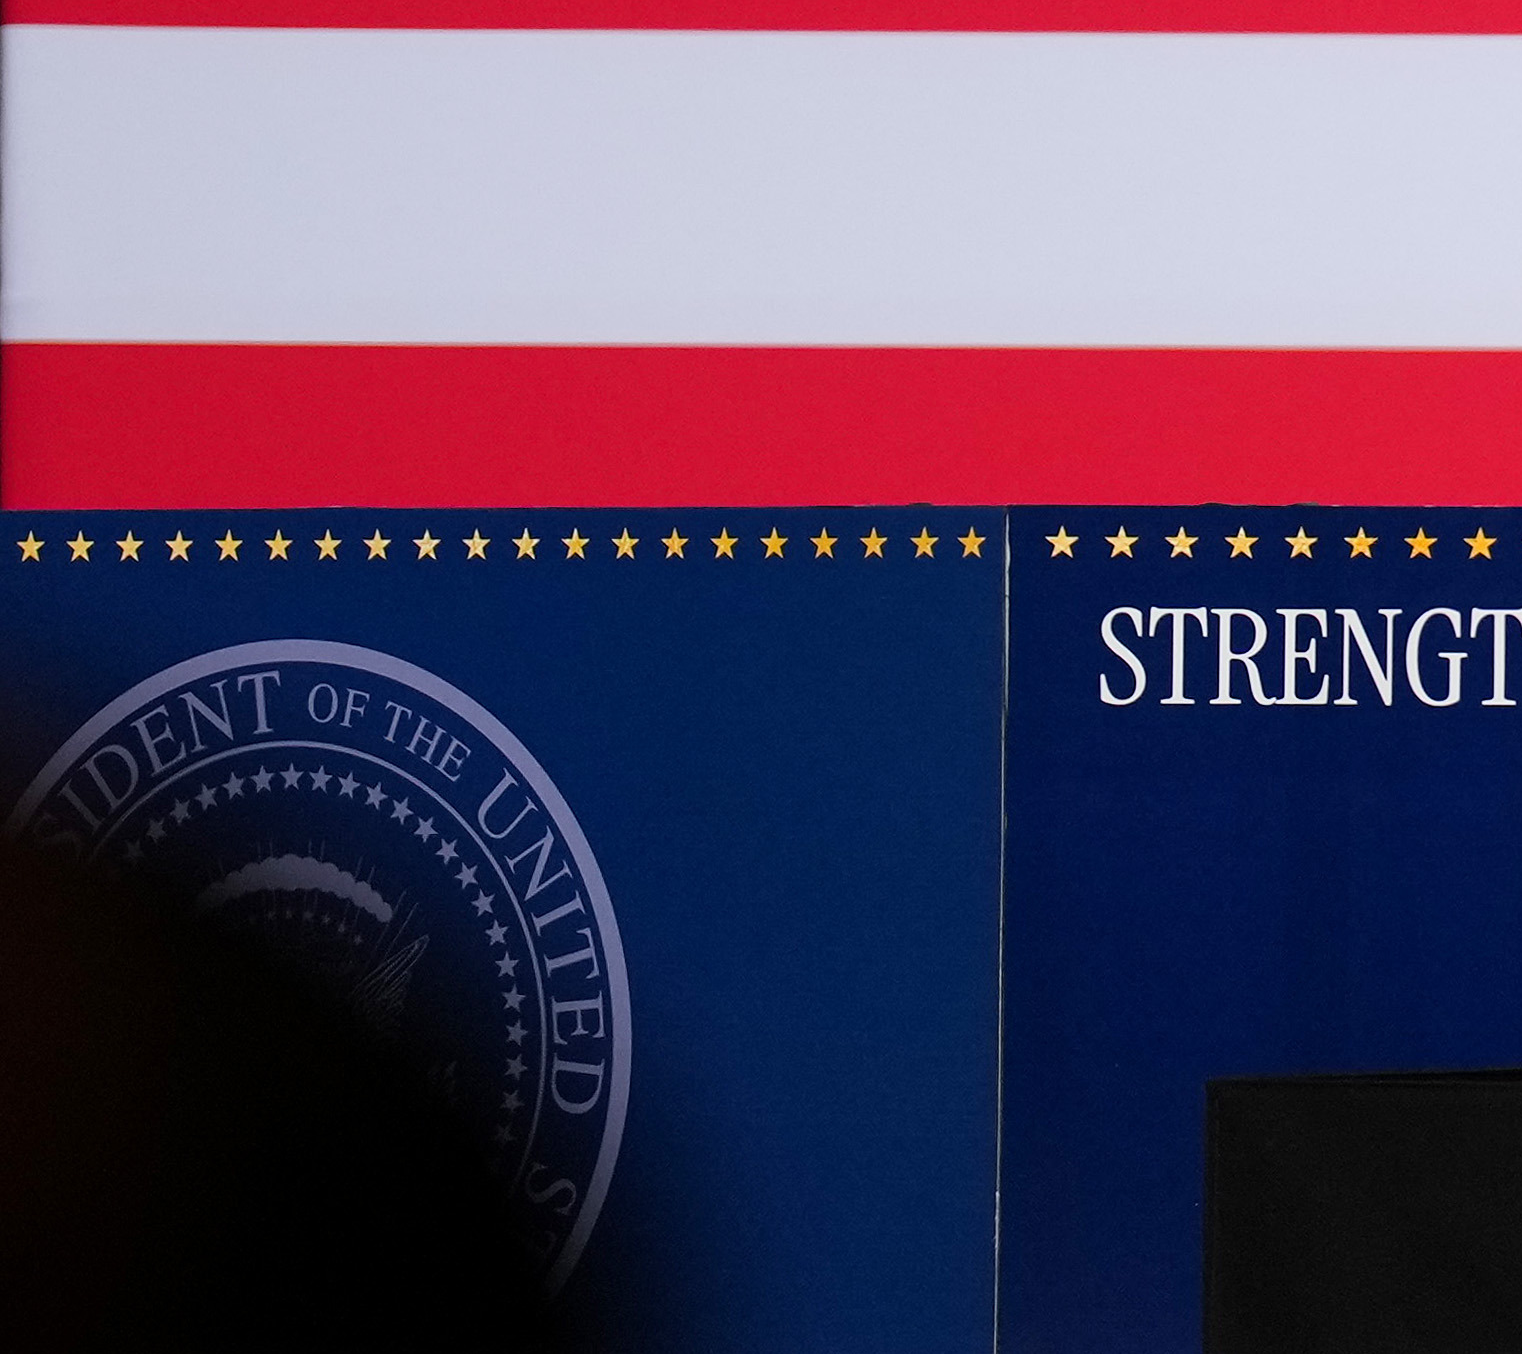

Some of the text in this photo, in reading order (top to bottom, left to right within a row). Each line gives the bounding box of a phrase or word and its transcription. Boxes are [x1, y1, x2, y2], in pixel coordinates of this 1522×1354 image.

[306, 682, 371, 725] OF
[384, 699, 472, 783] THE
[476, 767, 608, 1116] UNITED
